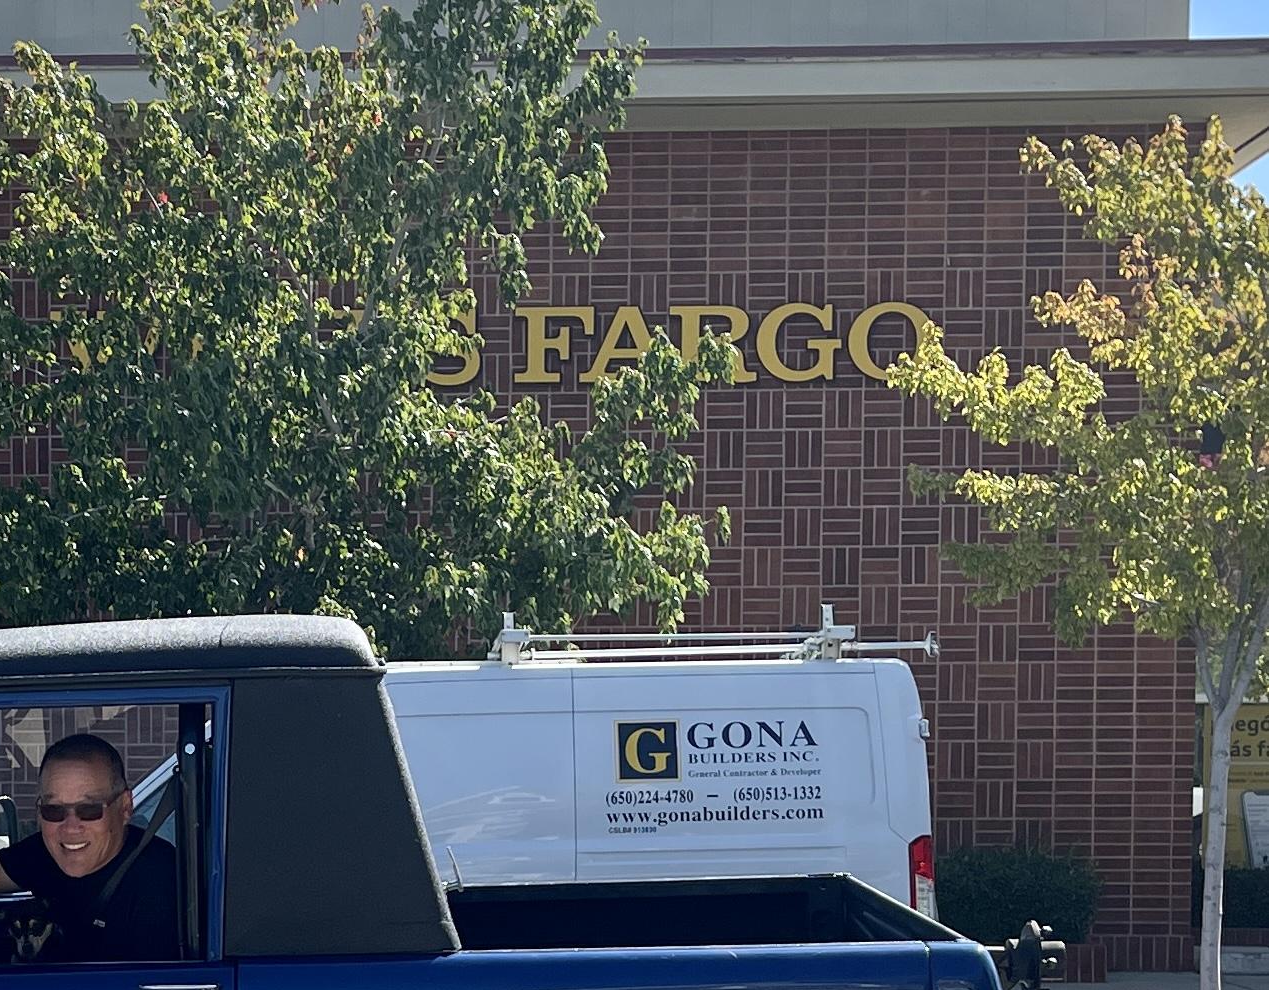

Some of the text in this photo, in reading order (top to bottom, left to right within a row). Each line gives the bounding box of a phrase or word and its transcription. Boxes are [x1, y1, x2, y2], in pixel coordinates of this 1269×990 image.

[515, 302, 930, 384] FARGO
[687, 720, 819, 750] GONA
[624, 727, 672, 774] G
[688, 750, 820, 764] BUILDERS INC.
[688, 768, 821, 778] General Contractor & Developer
[605, 789, 694, 806] (650)224-4780
[733, 785, 822, 804] (650)513-1332
[606, 805, 824, 826] www.gonabuilders.com
